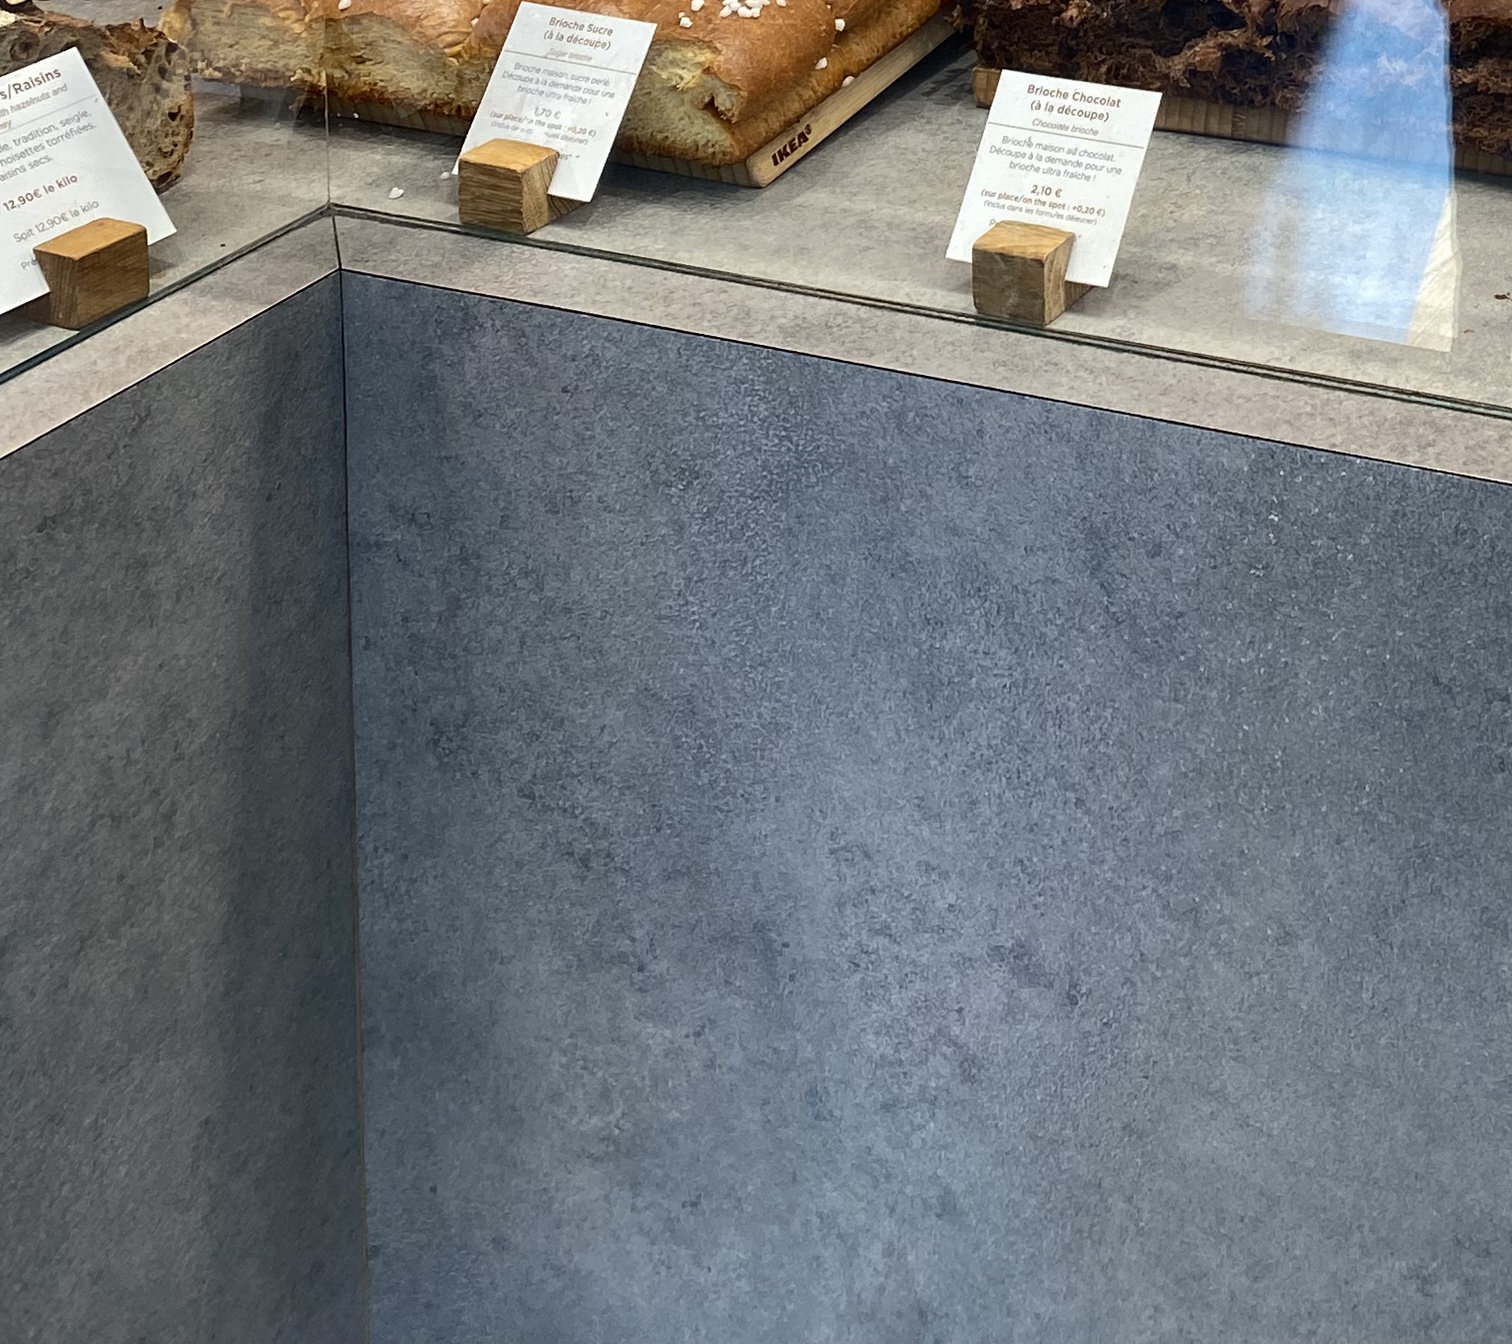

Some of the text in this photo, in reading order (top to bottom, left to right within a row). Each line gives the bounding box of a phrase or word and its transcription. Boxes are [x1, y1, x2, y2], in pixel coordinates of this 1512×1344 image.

[549, 17, 613, 36] Brioche Sucre
[544, 31, 611, 51] (à la découpe)
[10, 83, 68, 113] hazelnuts and
[1027, 84, 1121, 108] Brioche Chocolat
[534, 106, 561, 120] 1,70 €
[1031, 100, 1109, 122] (à la découpe)
[13, 109, 92, 148] tradition, seigle,
[46, 123, 97, 148] torréfiées.
[3, 174, 78, 212] 12,90€ le kilo
[1031, 185, 1062, 197] 2,10 €
[13, 226, 35, 243] Soit
[70, 207, 80, 219] le
[81, 200, 99, 214] kilo
